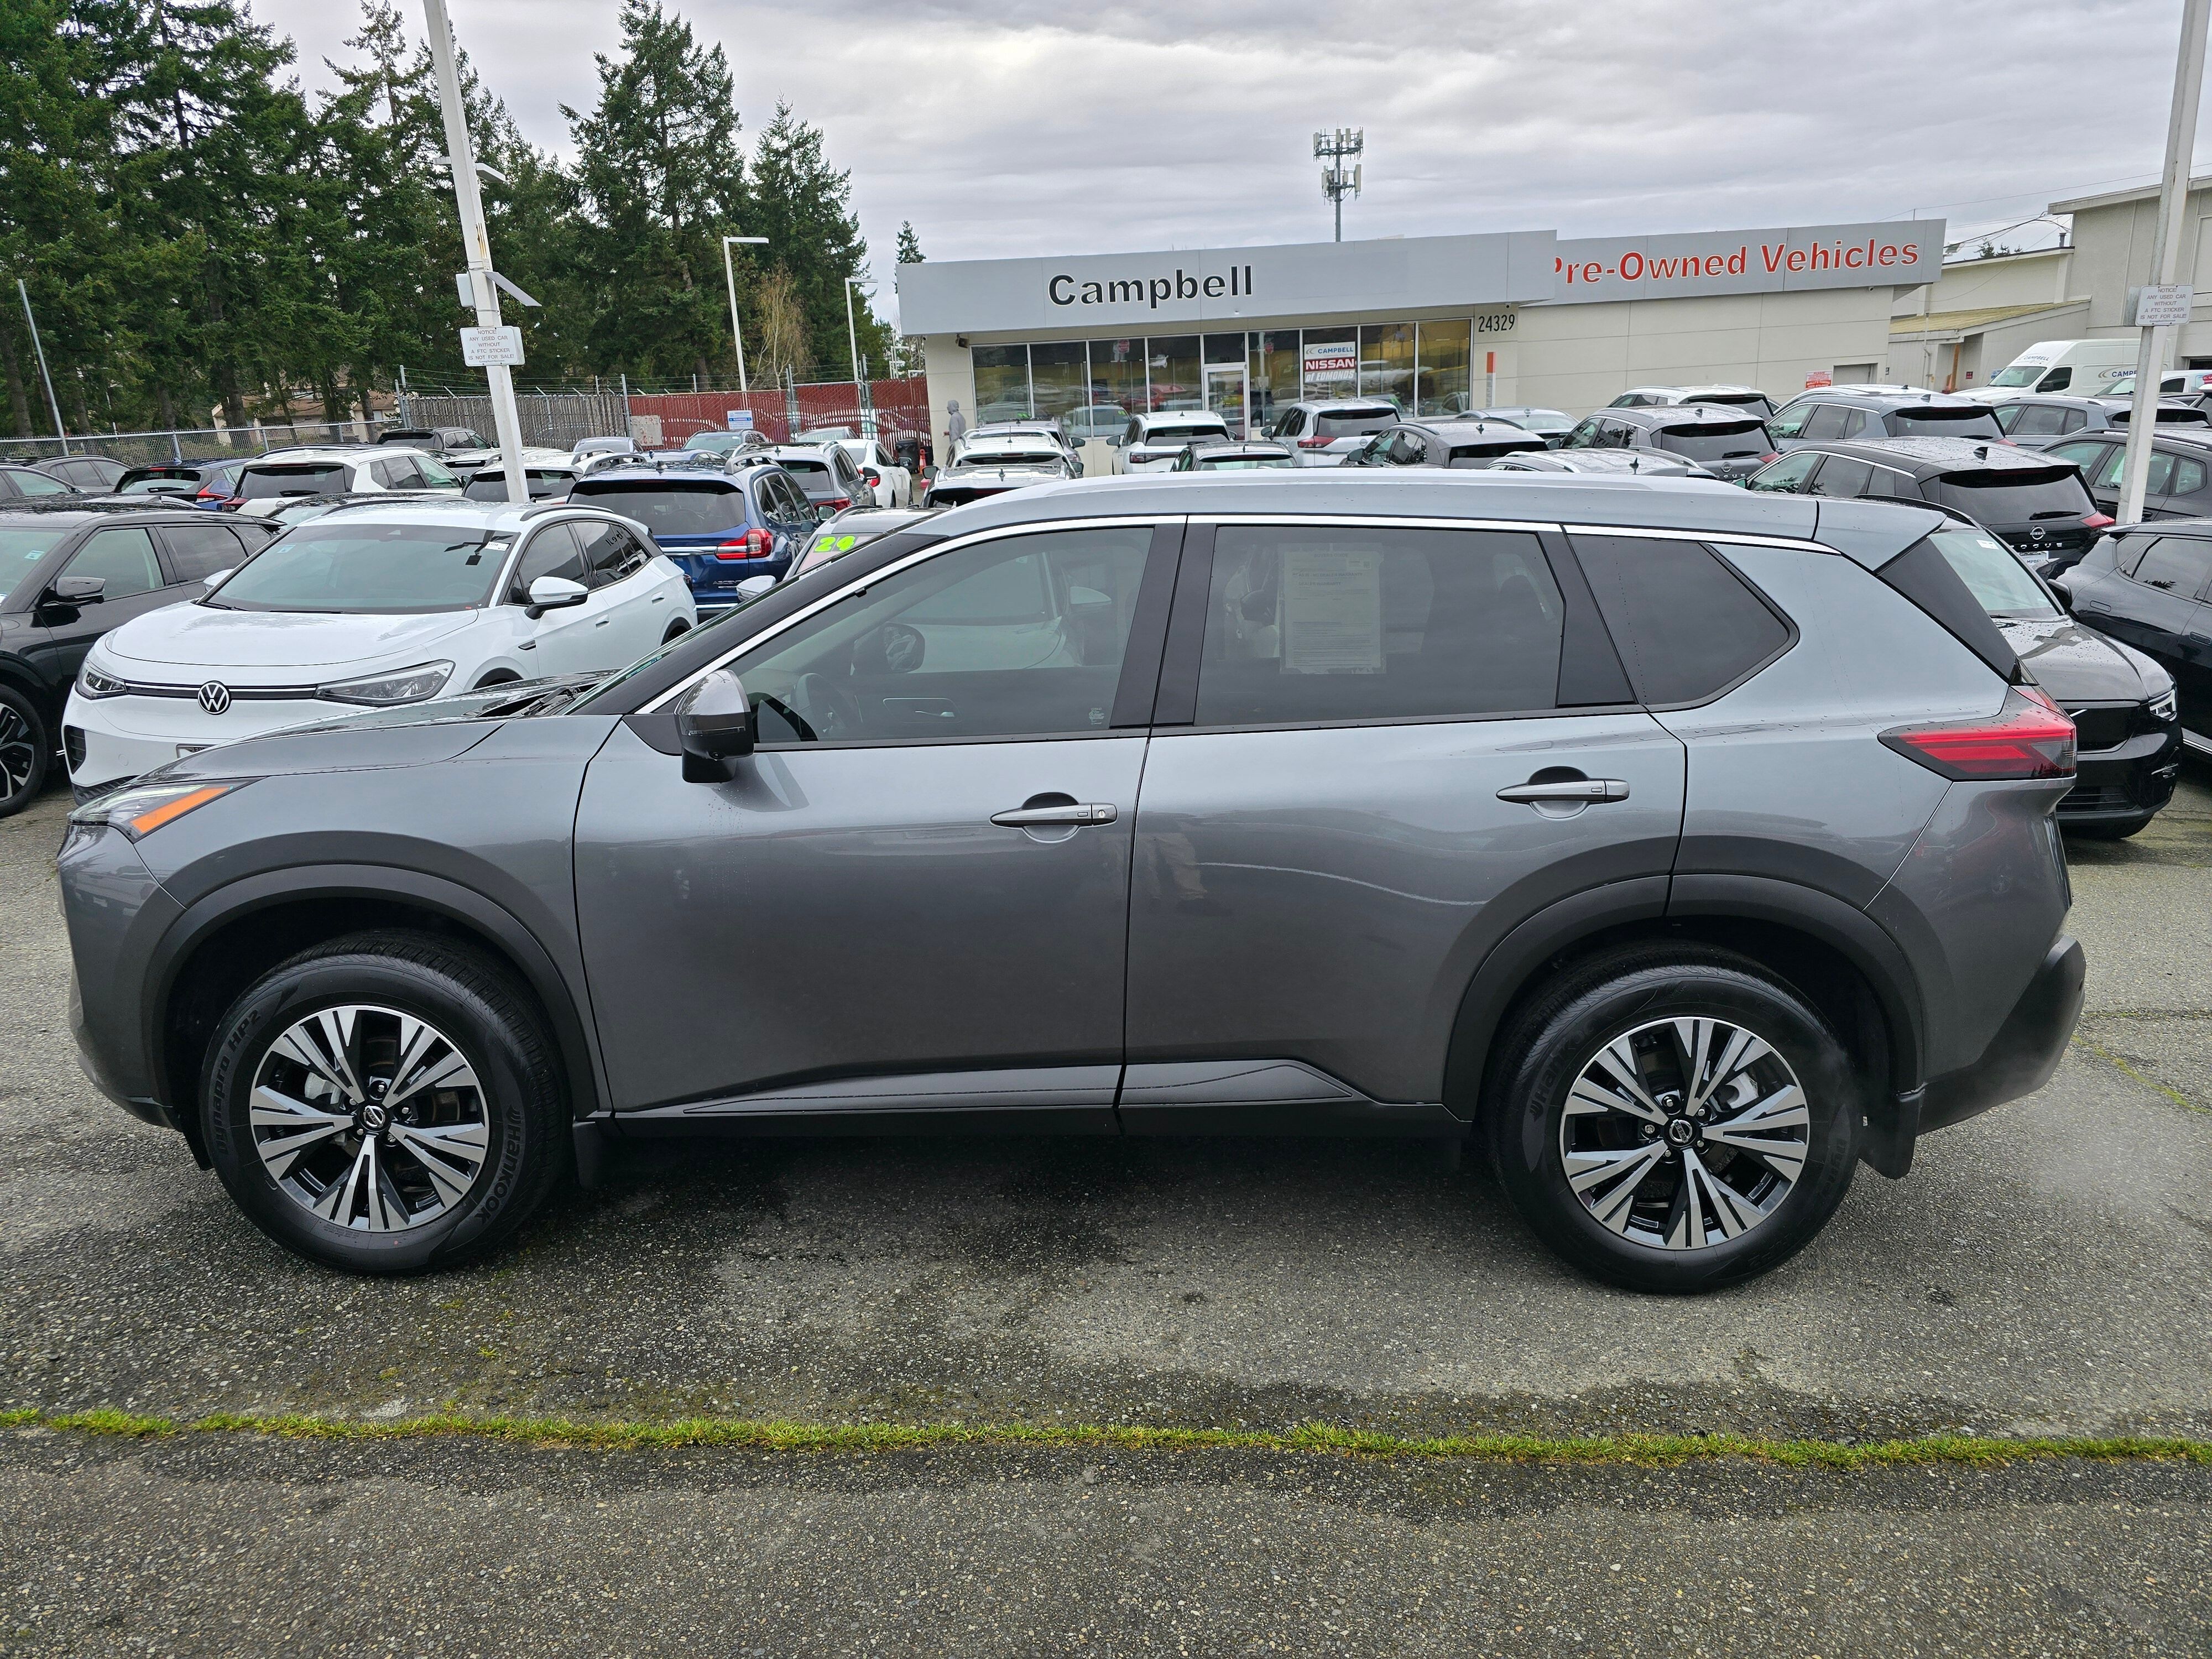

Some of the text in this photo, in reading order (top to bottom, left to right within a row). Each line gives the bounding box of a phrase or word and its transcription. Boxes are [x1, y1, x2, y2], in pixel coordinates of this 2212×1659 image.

[1760, 238, 1919, 274] Vehicles
[1048, 264, 1252, 310] Campbell
[1479, 314, 1515, 332] 24329
[1306, 358, 1354, 371] NISSAN
[1306, 370, 1355, 382] of EDMONDS
